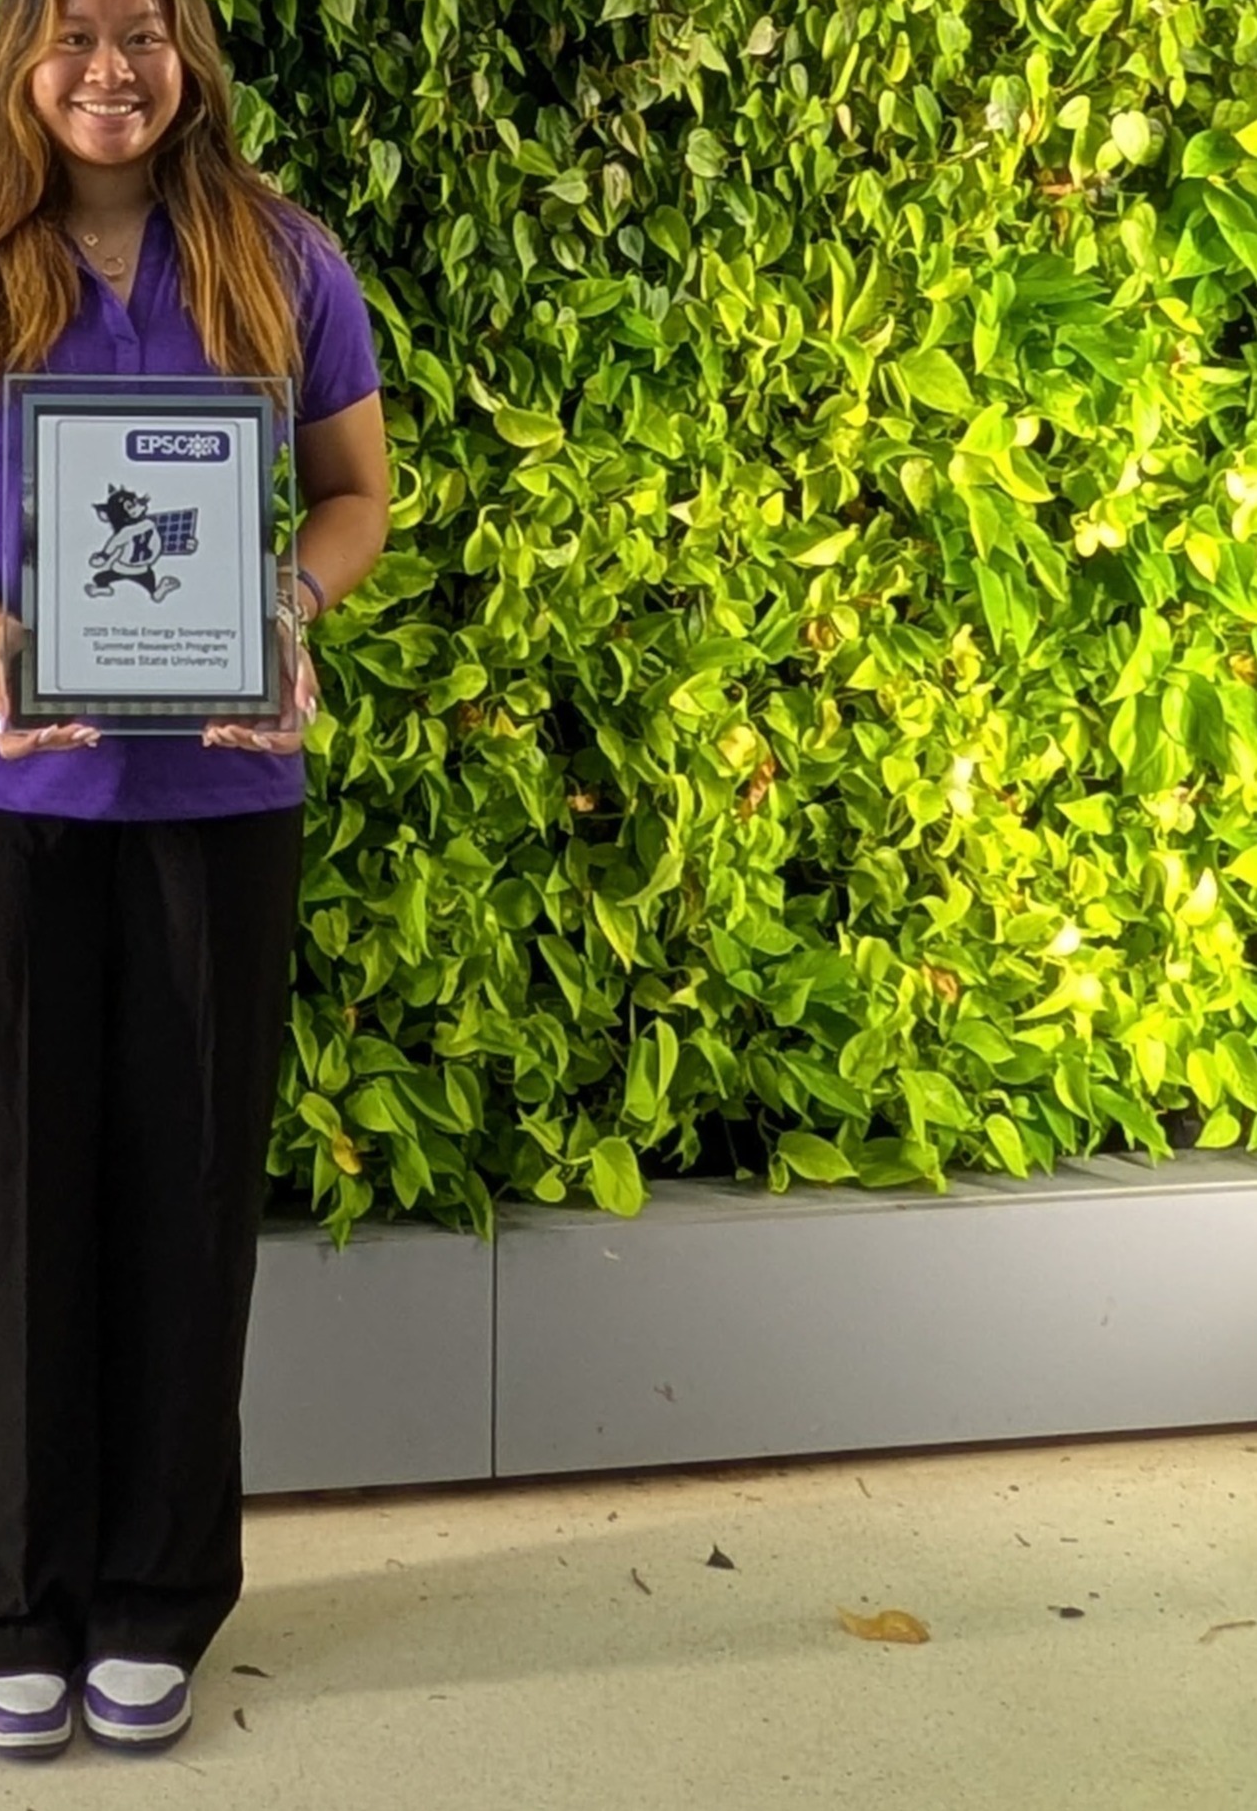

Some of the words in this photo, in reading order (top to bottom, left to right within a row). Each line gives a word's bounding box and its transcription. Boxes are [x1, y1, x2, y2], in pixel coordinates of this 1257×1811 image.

[129, 529, 154, 564] K
[83, 627, 109, 637] 2025
[111, 627, 139, 637] Tribal
[141, 627, 175, 639] Energy
[178, 627, 237, 639] Sovereignty
[93, 641, 135, 651] Summer
[137, 641, 183, 651] Research
[185, 642, 228, 653] Program
[96, 655, 136, 666] Kansas
[138, 655, 168, 666] State
[170, 655, 229, 668] University
